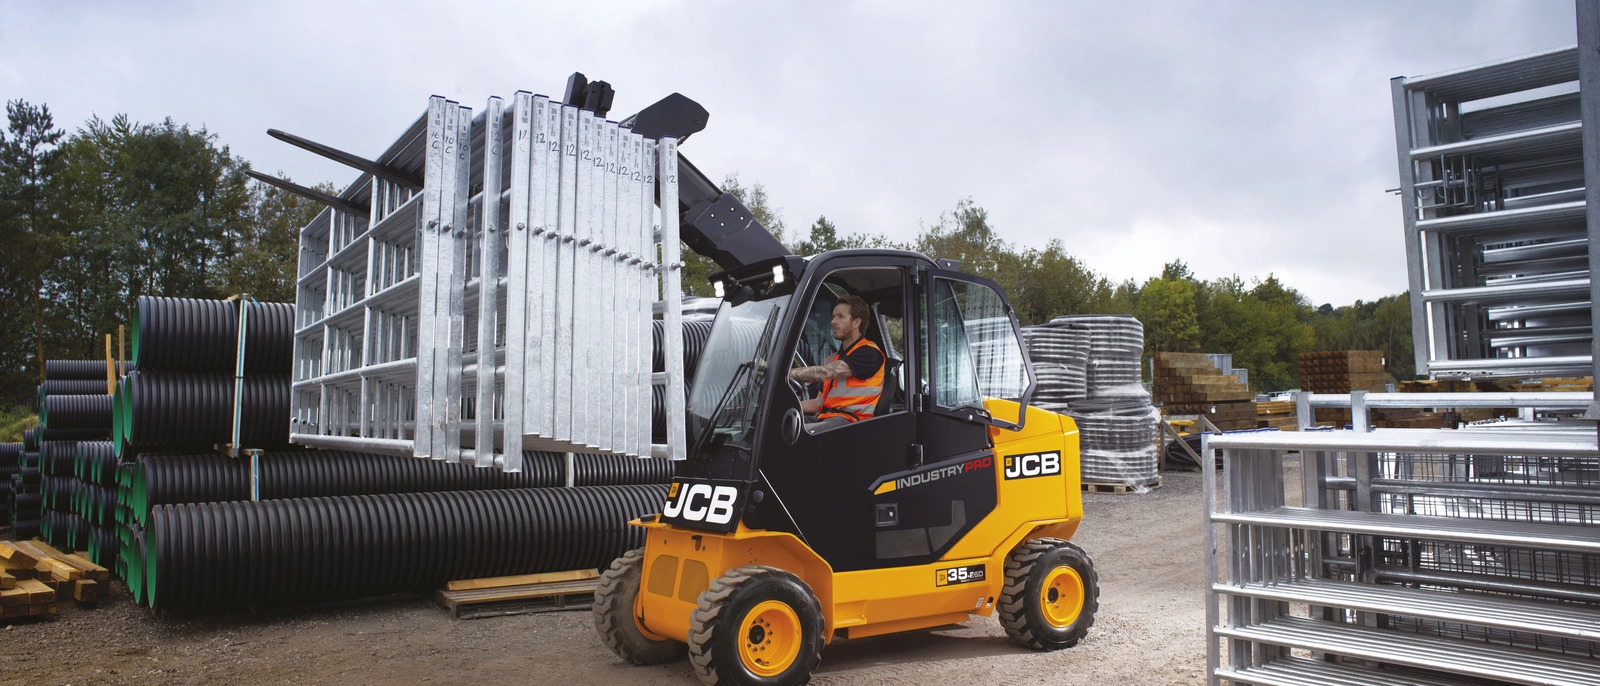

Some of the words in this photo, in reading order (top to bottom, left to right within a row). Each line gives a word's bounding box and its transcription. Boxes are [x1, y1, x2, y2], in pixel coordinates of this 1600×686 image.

[536, 132, 546, 144] 12
[431, 140, 439, 150] C
[445, 146, 453, 154] C
[548, 140, 560, 152] 12
[566, 144, 576, 156] 12
[580, 150, 592, 161] 12
[594, 157, 604, 168] 12
[606, 162, 616, 174] 12
[618, 166, 629, 176] 12
[630, 172, 642, 182] 12
[644, 176, 653, 184] 12
[666, 174, 676, 184] 12
[1006, 452, 1060, 478] JCB
[664, 484, 738, 524] JCB
